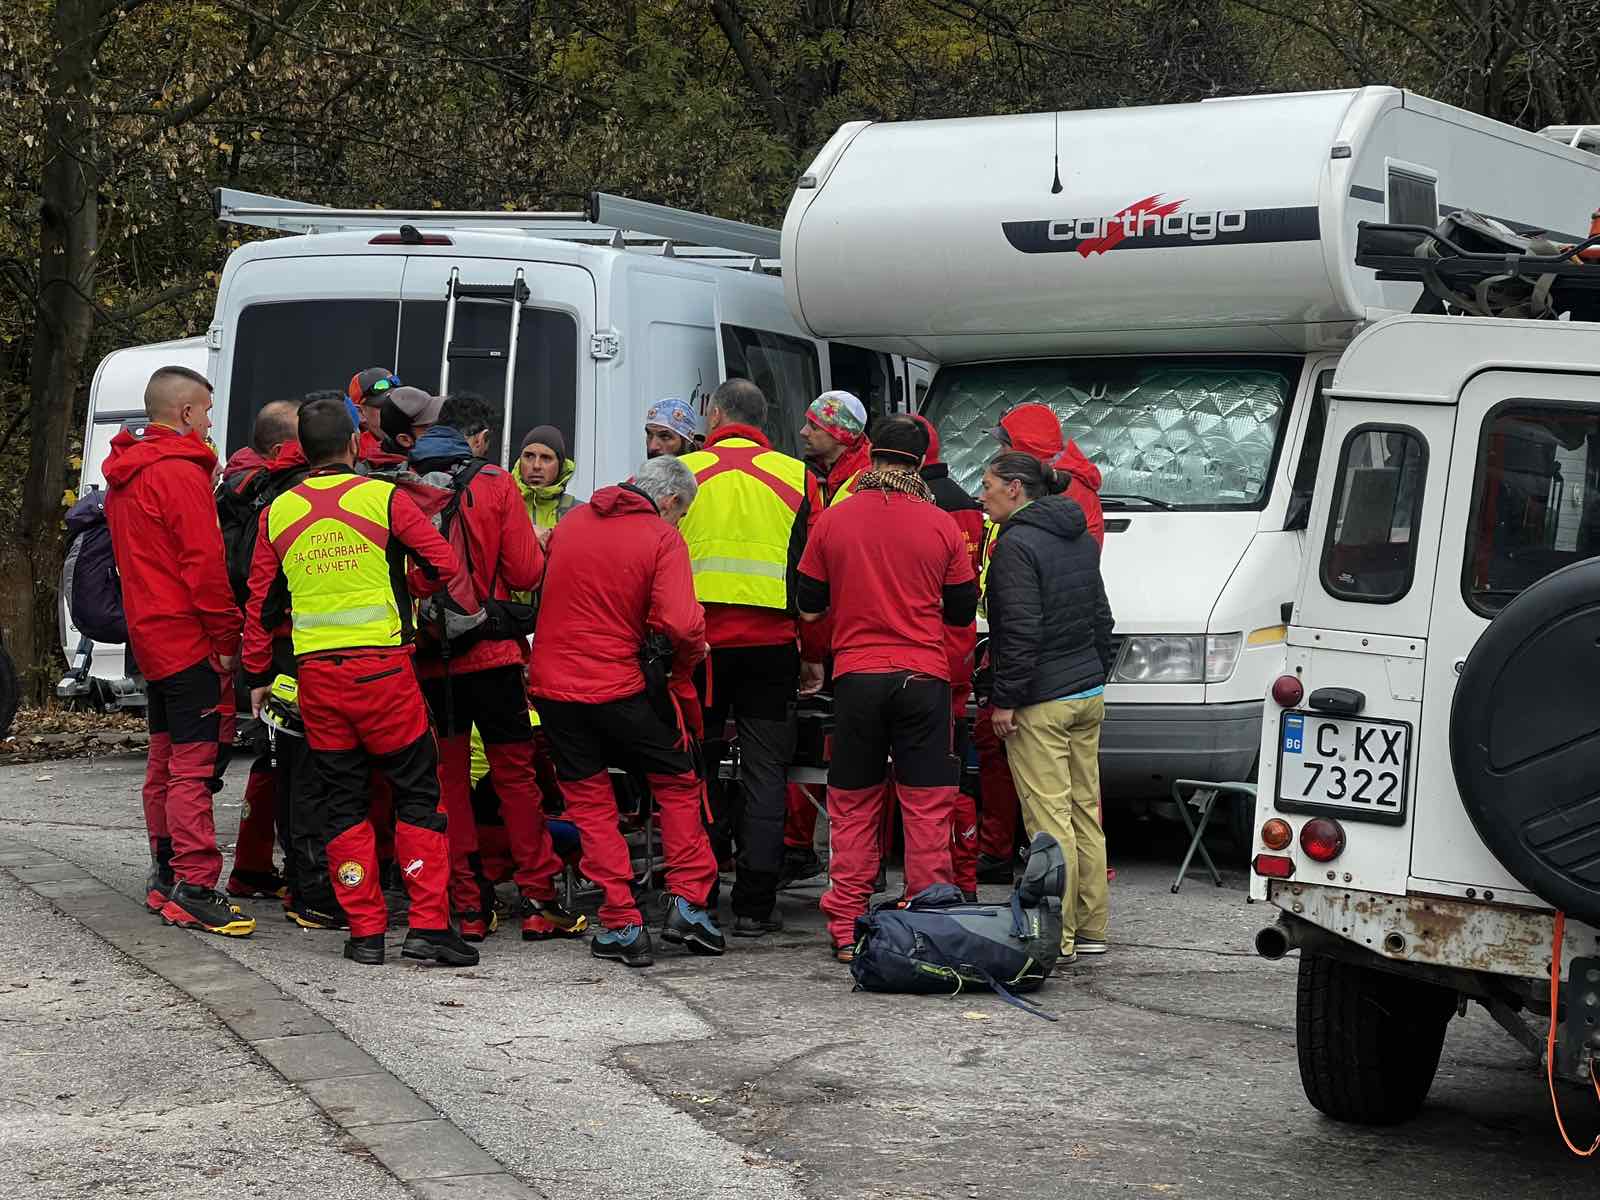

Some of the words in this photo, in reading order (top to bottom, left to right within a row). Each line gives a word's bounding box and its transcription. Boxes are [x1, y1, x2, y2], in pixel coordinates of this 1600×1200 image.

[1048, 209, 1247, 240] carthago
[310, 531, 344, 545] ГРУПА
[294, 553, 304, 563] ЗА
[307, 543, 369, 560] СПАСЯВАНЕ
[305, 565, 312, 575] С
[317, 559, 358, 574] КУЧЕТА
[1286, 738, 1300, 749] BG
[1316, 723, 1339, 757] C
[1354, 726, 1402, 765] KX
[1302, 762, 1398, 807] 7322
